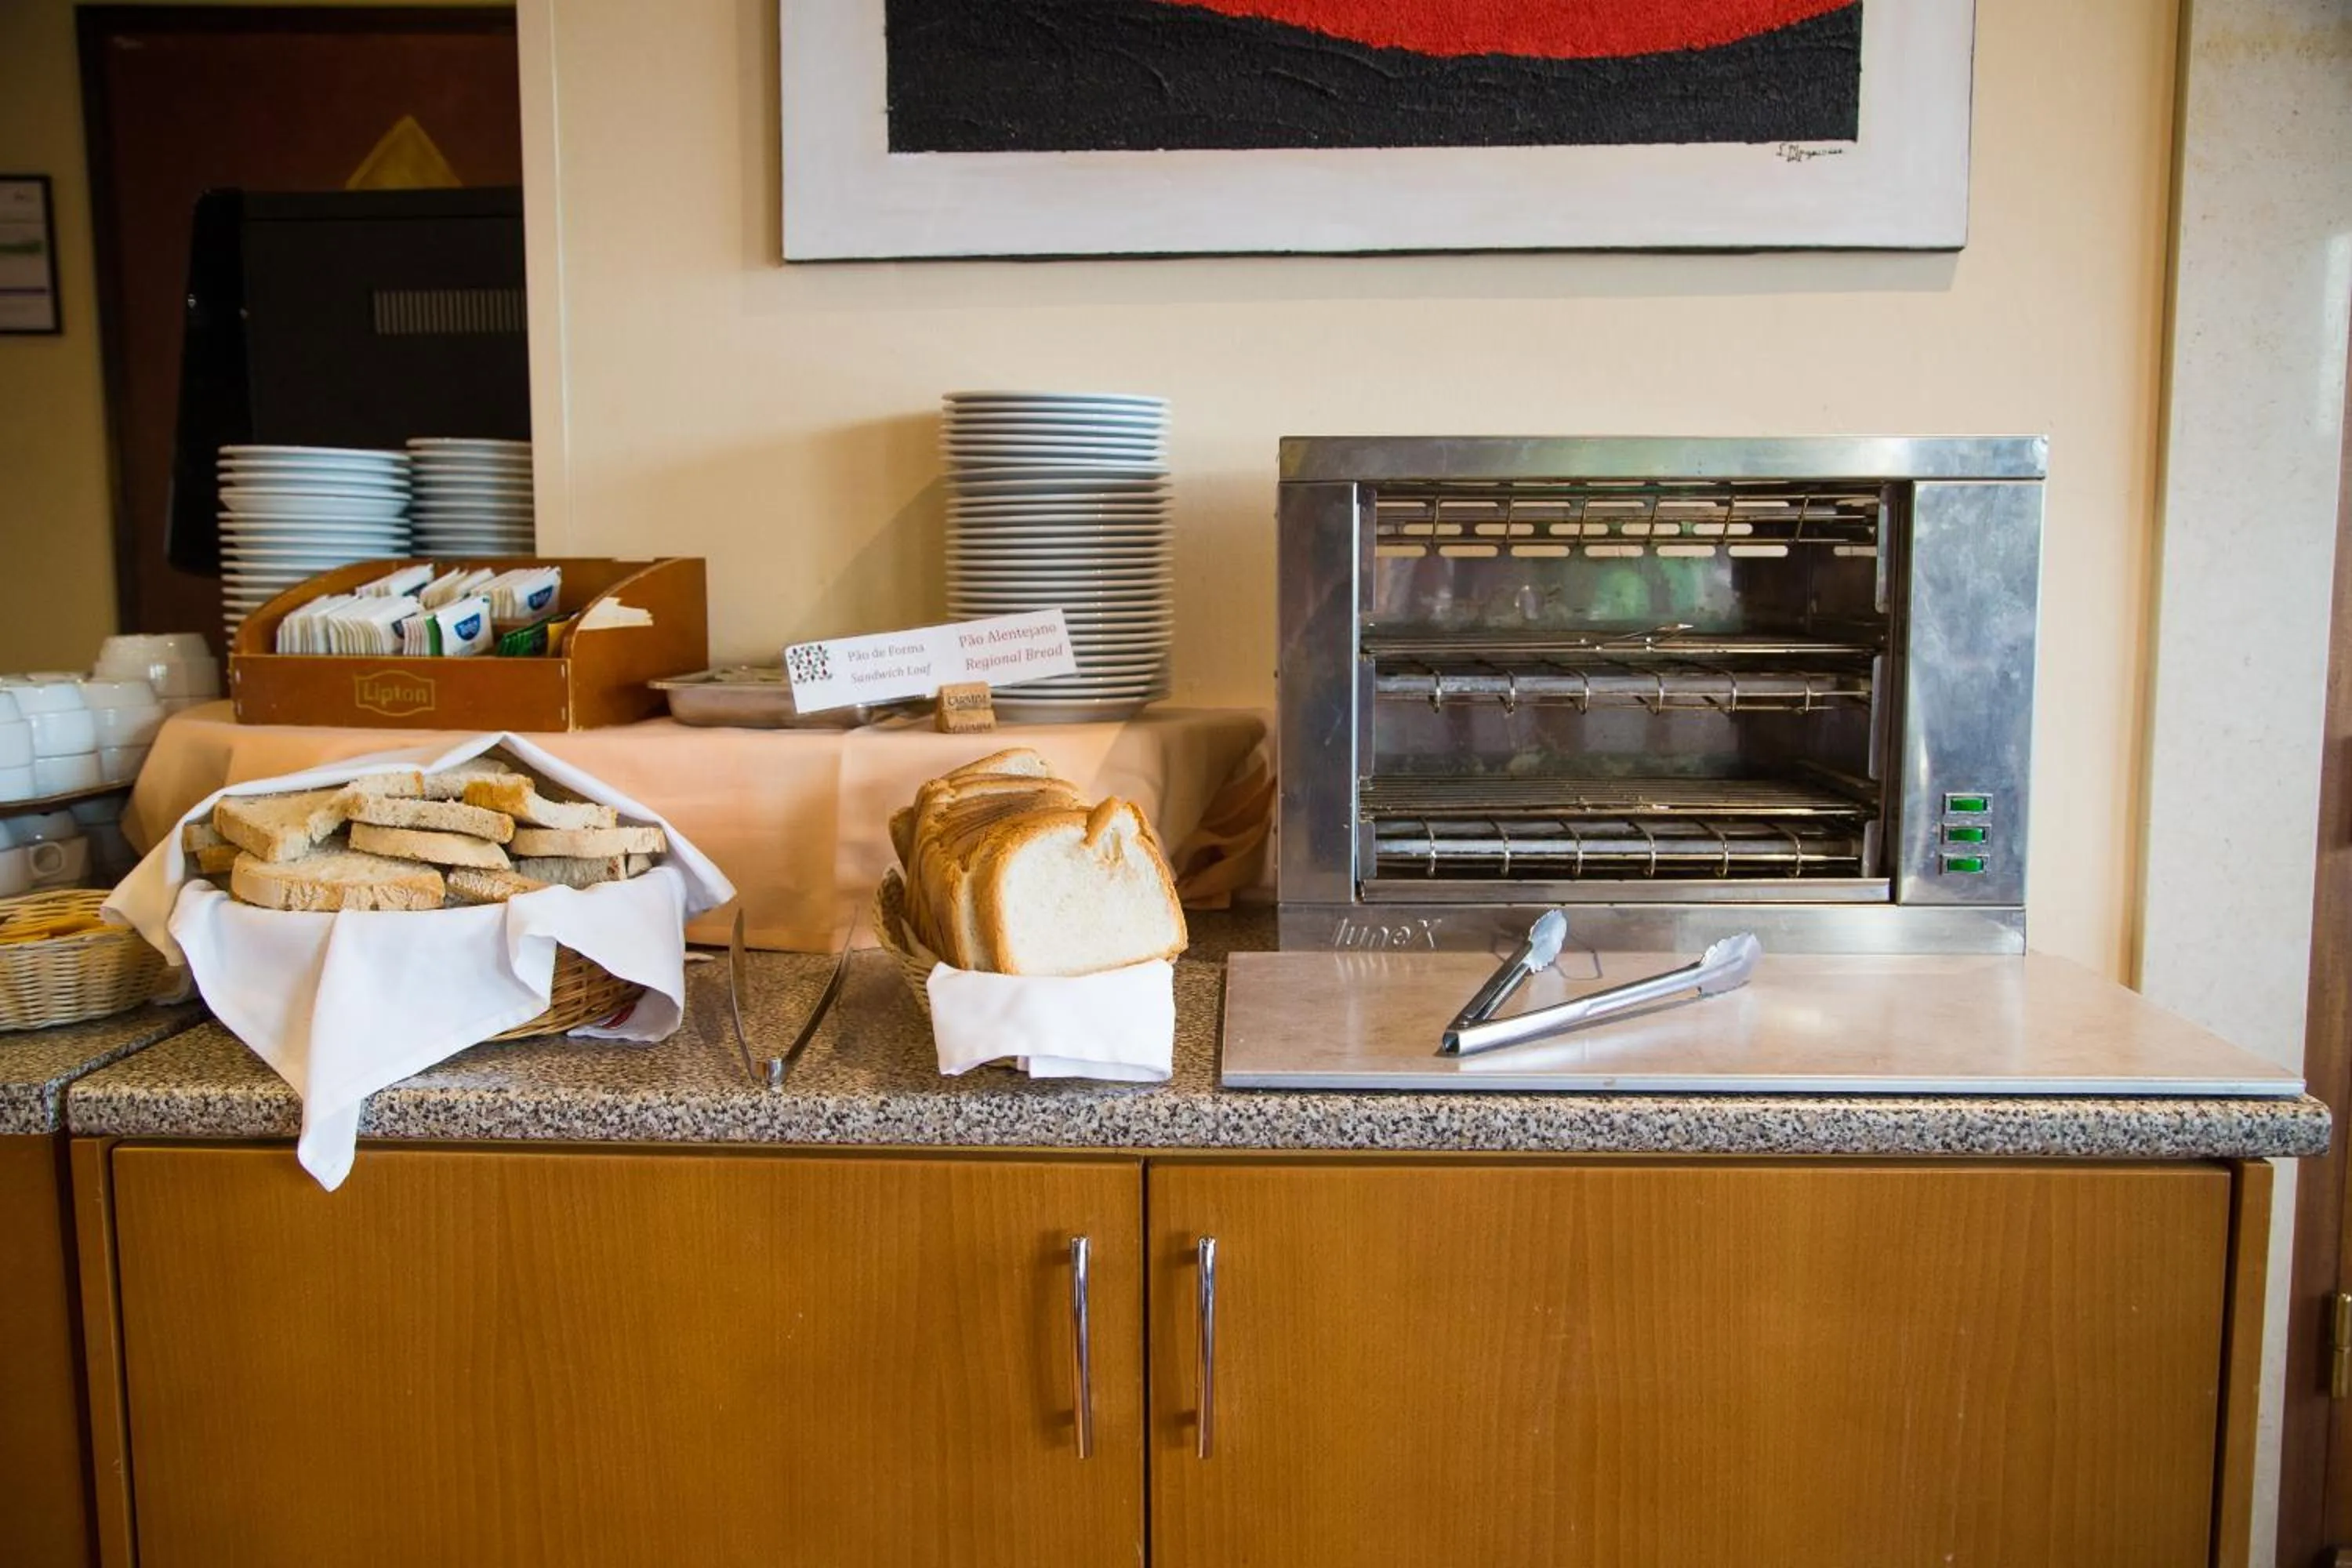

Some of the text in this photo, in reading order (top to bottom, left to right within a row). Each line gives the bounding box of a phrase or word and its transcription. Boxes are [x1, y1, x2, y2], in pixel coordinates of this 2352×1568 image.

[959, 623, 1057, 648] Pão Alentejano
[848, 644, 925, 662] Pão de Forma
[966, 644, 1063, 671] Regional Bread
[851, 662, 931, 684] Sandwich Loaf
[364, 681, 427, 708] Lipton
